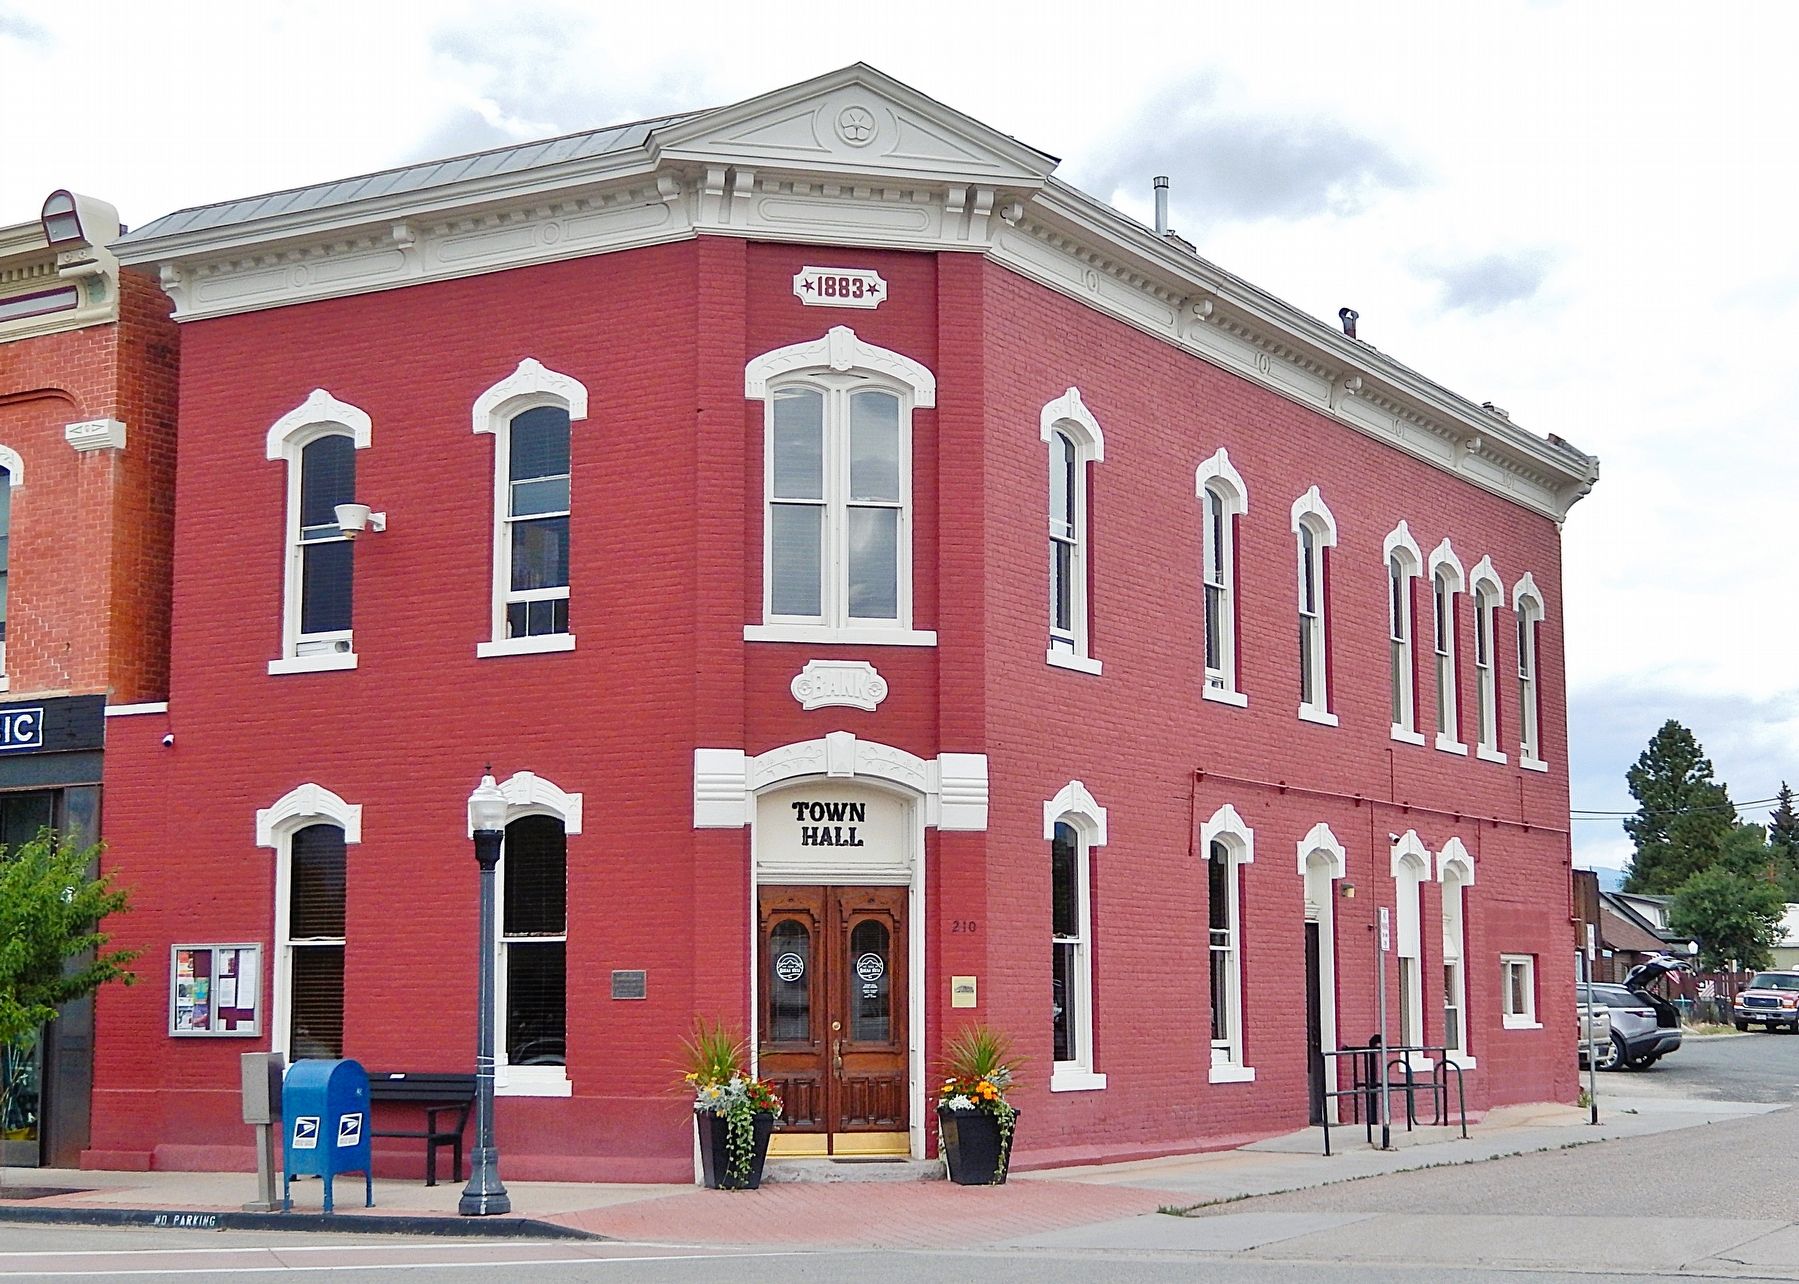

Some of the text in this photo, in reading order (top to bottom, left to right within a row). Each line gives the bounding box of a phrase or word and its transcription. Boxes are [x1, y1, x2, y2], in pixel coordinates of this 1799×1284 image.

[817, 276, 864, 299] 1883
[811, 670, 869, 701] BANK
[0, 714, 34, 742] IC
[791, 801, 866, 822] TOWN
[801, 826, 864, 847] HALL
[952, 920, 977, 933] 210
[154, 1214, 216, 1227] NO PARKING
